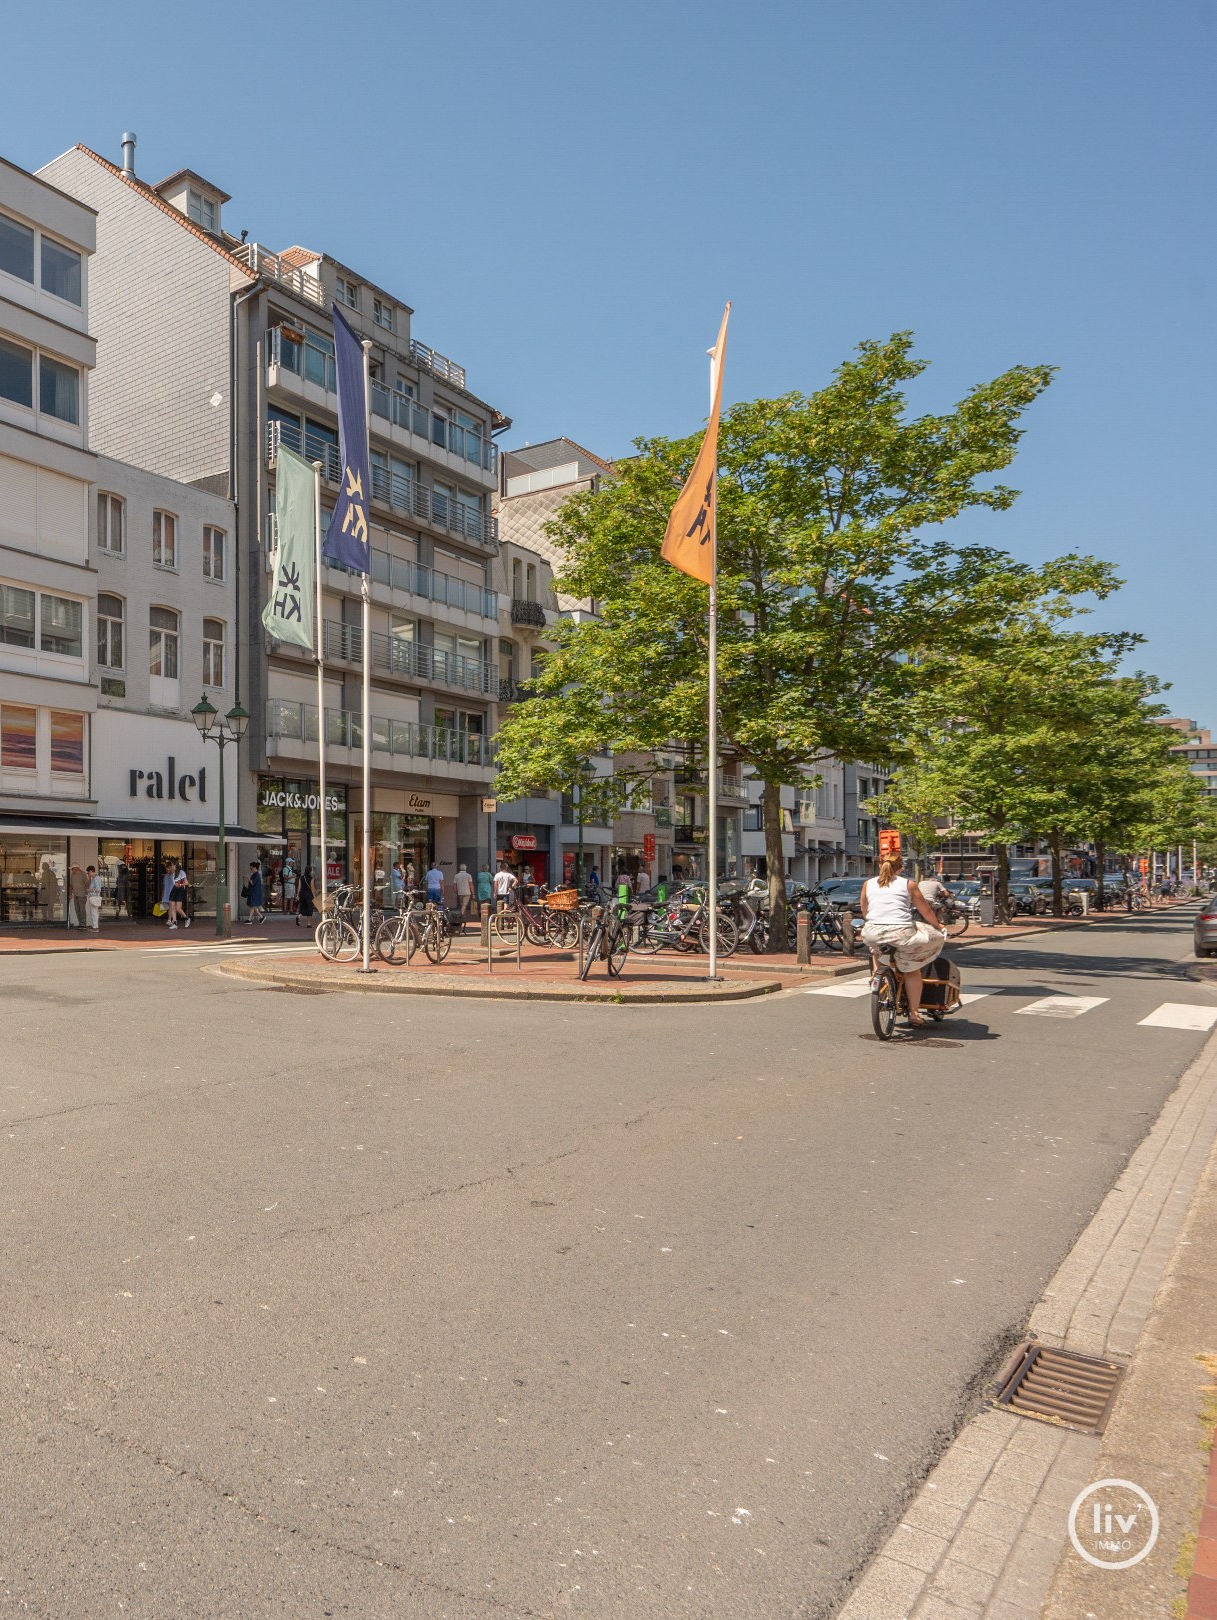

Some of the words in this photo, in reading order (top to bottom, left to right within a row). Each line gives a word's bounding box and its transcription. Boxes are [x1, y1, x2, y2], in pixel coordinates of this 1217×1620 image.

[129, 756, 207, 802] ralet
[408, 794, 431, 808] Etam
[327, 866, 340, 876] ALE
